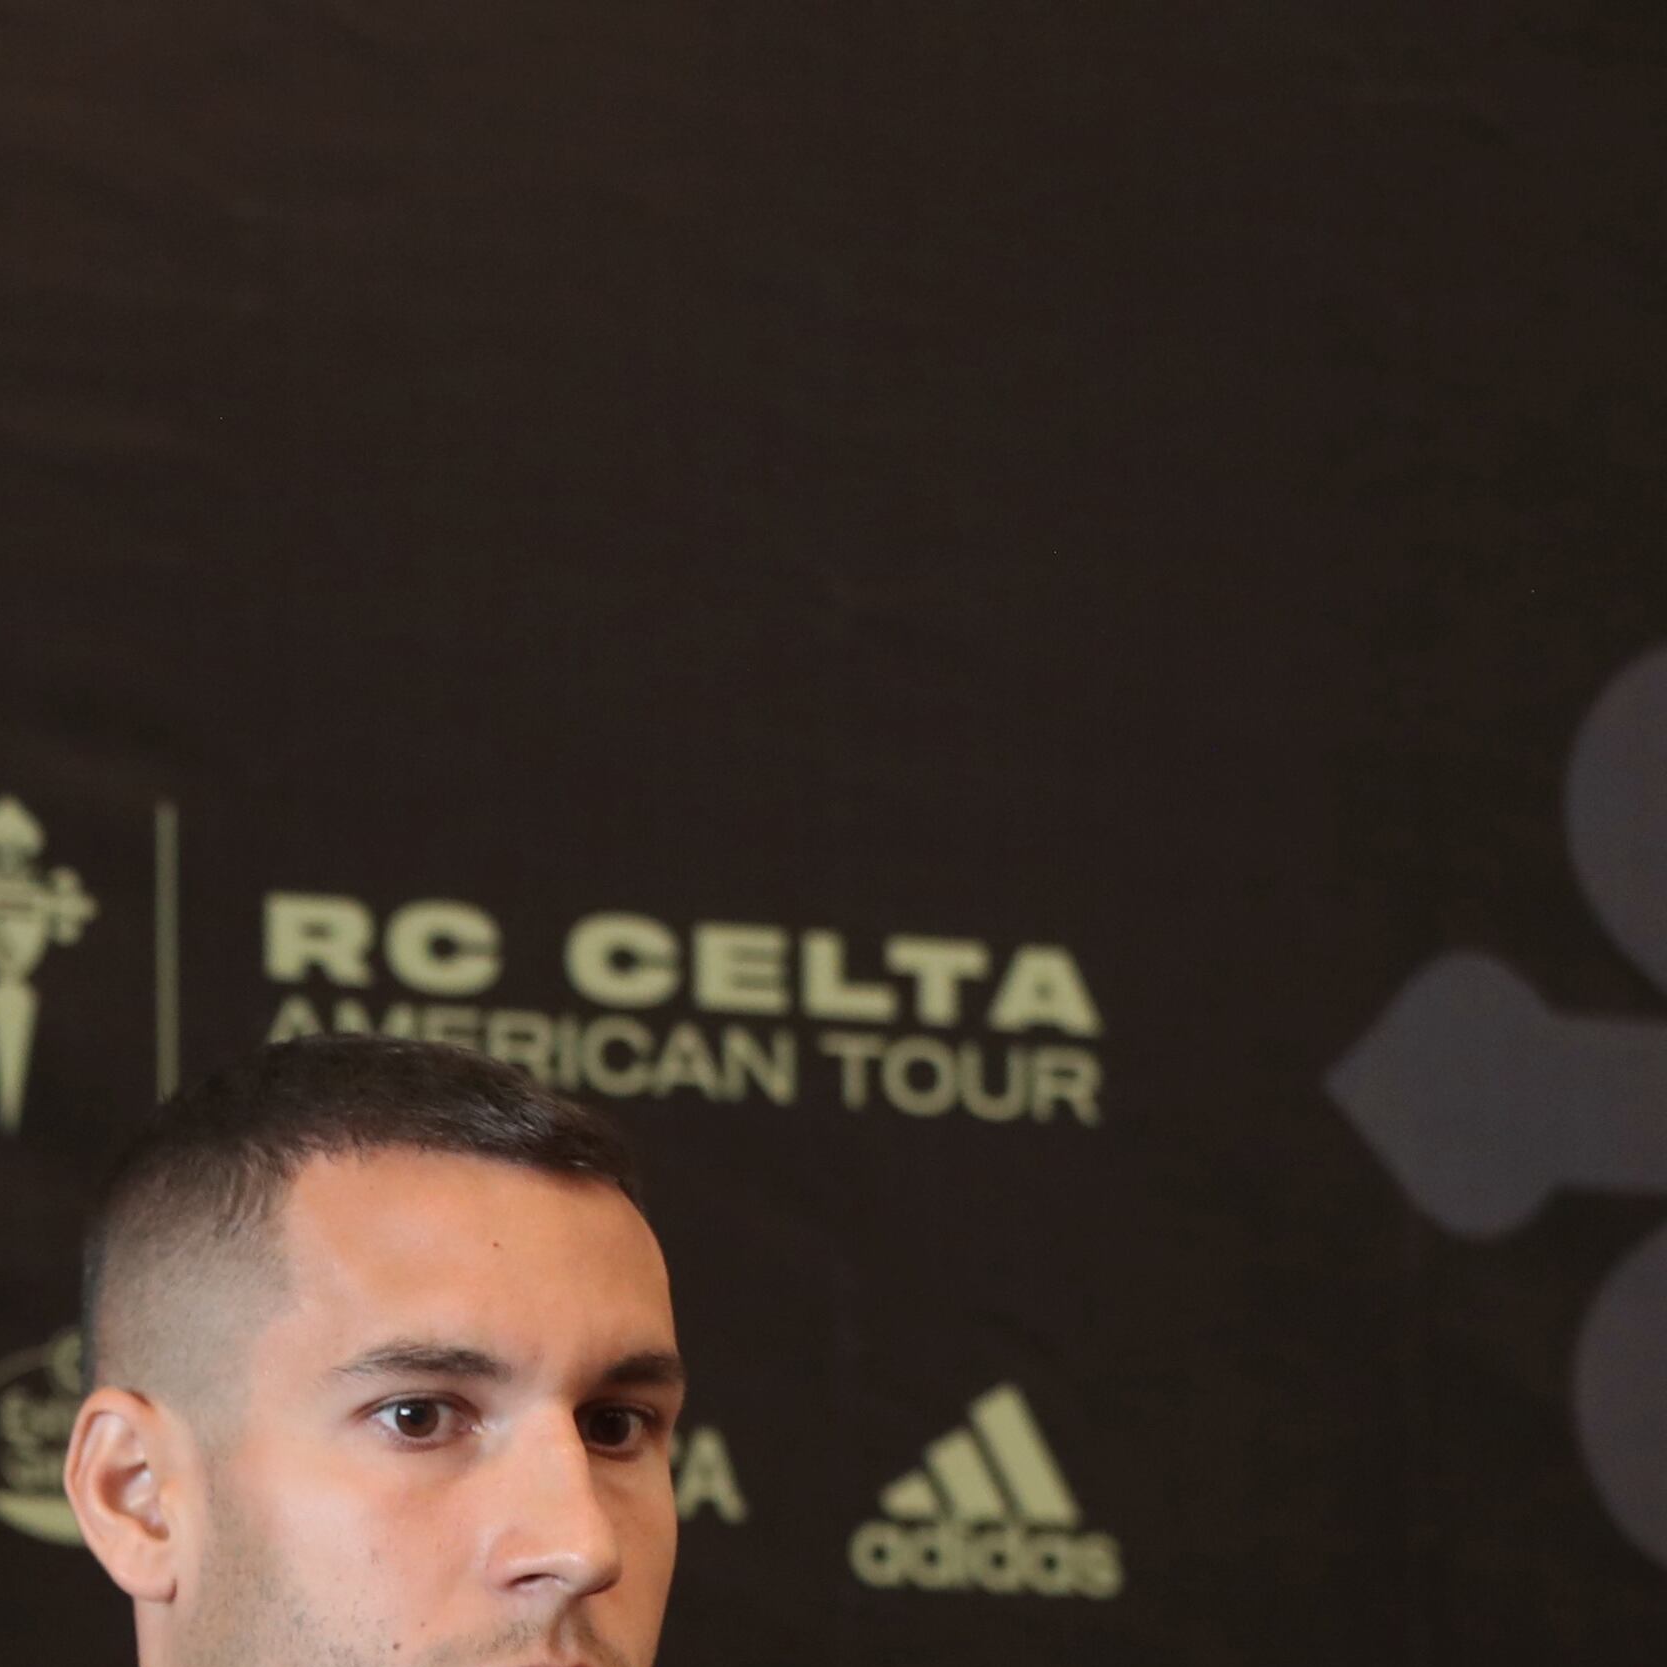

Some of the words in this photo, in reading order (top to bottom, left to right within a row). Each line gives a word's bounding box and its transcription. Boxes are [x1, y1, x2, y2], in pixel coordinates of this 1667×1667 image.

[265, 892, 503, 994] RC
[565, 911, 1102, 1038] CELTA
[817, 1033, 1102, 1126] TOUR
[848, 1518, 1124, 1600] adidas
